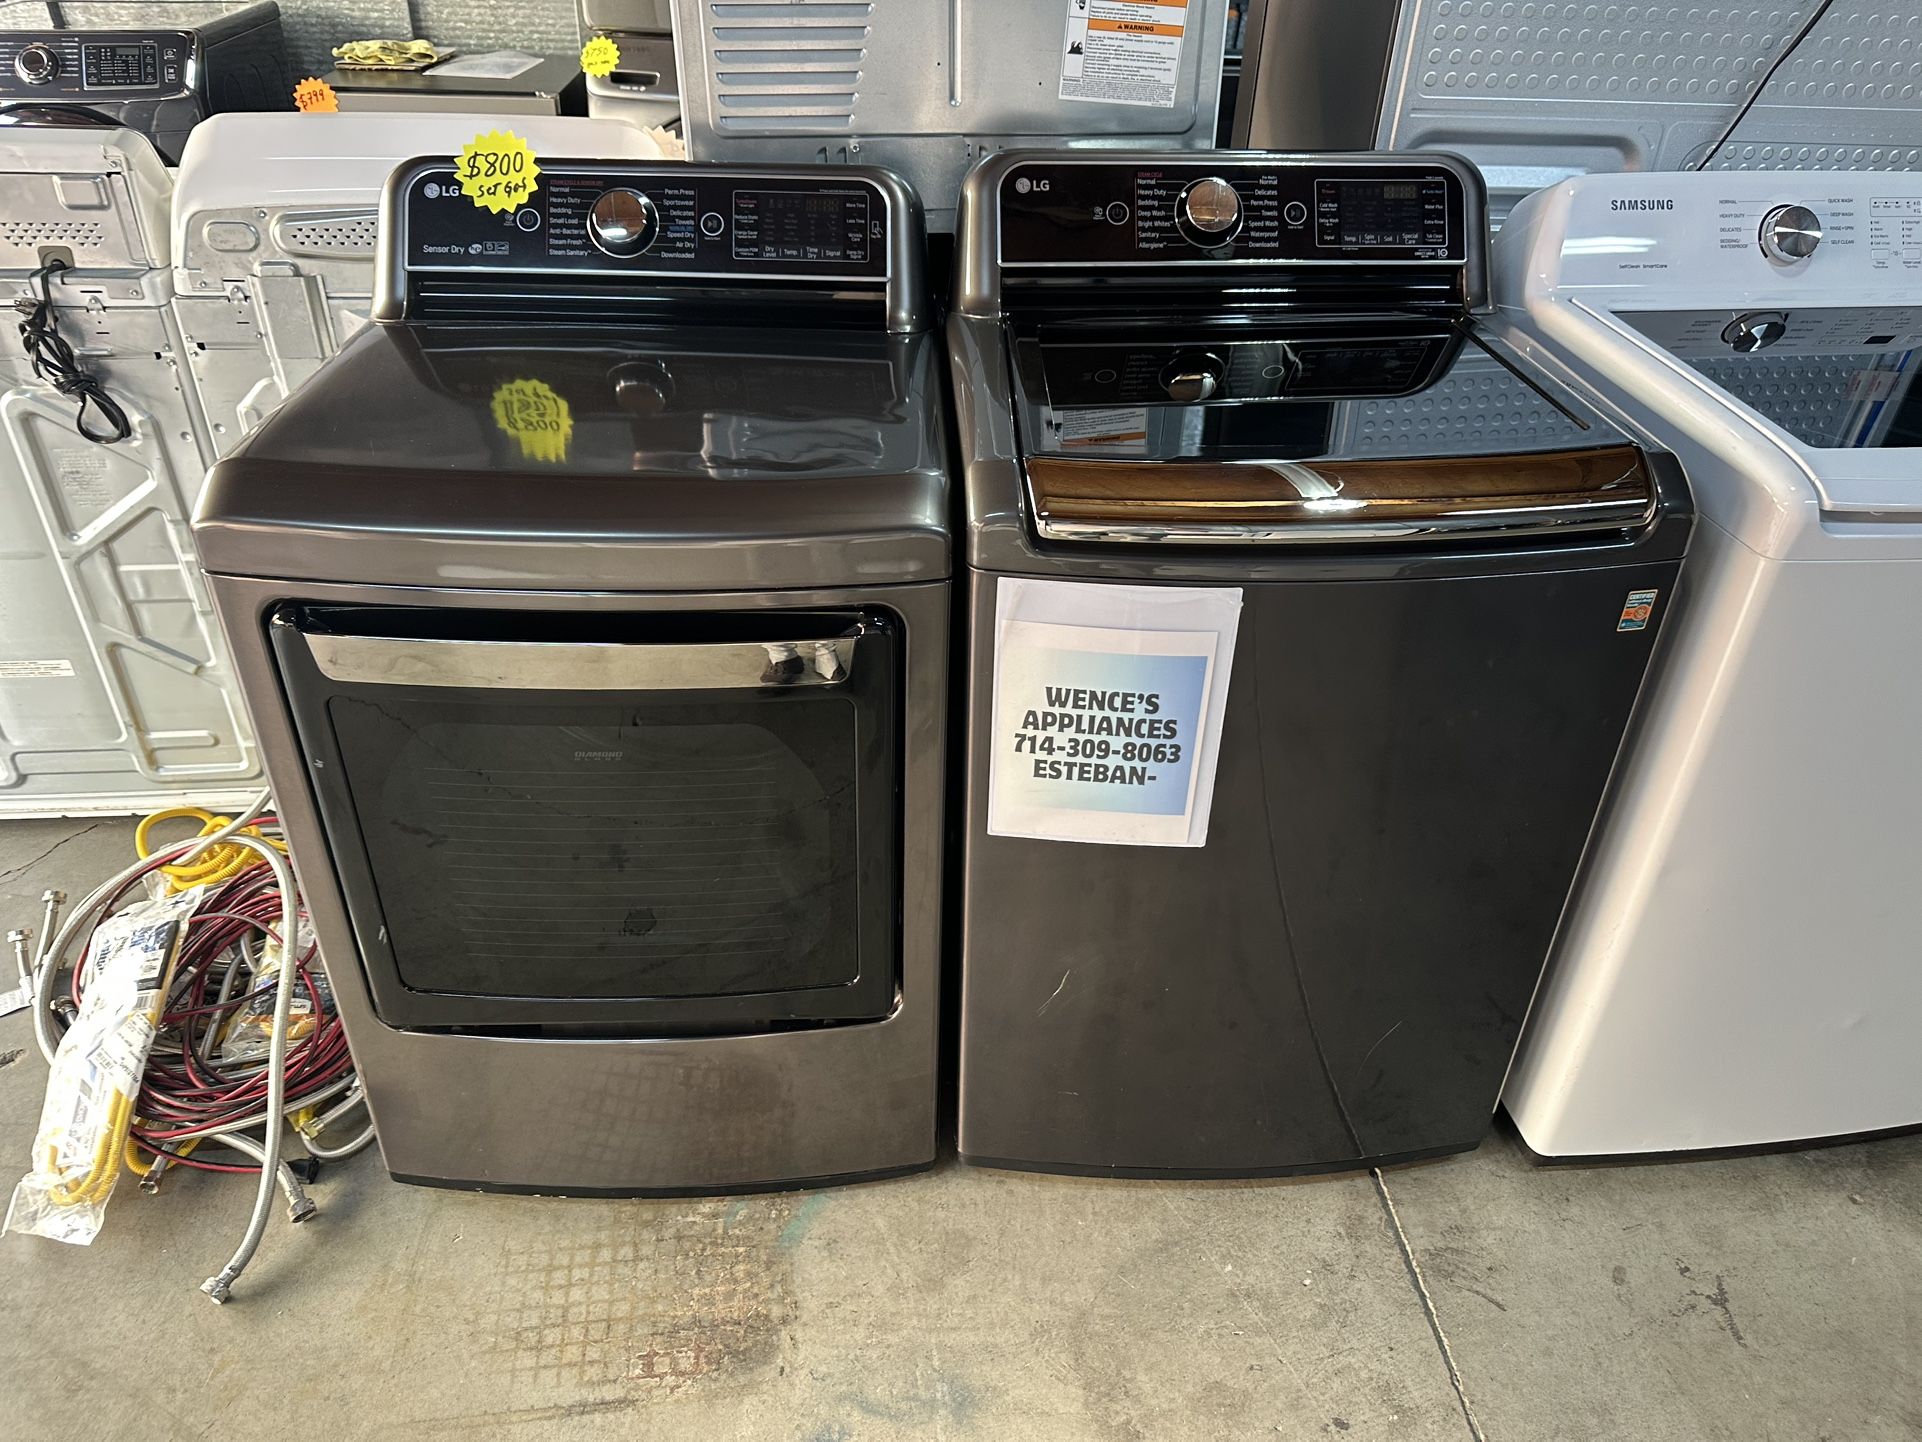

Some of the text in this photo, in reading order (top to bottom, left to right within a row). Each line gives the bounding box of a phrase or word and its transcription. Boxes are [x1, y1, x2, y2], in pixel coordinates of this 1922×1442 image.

[299, 89, 324, 110] $799
[463, 151, 524, 180] $800
[442, 186, 459, 196] LG
[1033, 180, 1050, 191] LG
[1611, 199, 1674, 210] SAMSUNG
[423, 245, 465, 255] Sensor Dry
[1045, 686, 1160, 714] WENCE'S
[1022, 710, 1178, 740] APPLIANCES
[1014, 733, 1181, 763] 714-309-8063
[1033, 758, 1157, 785] ESTEBAN-
